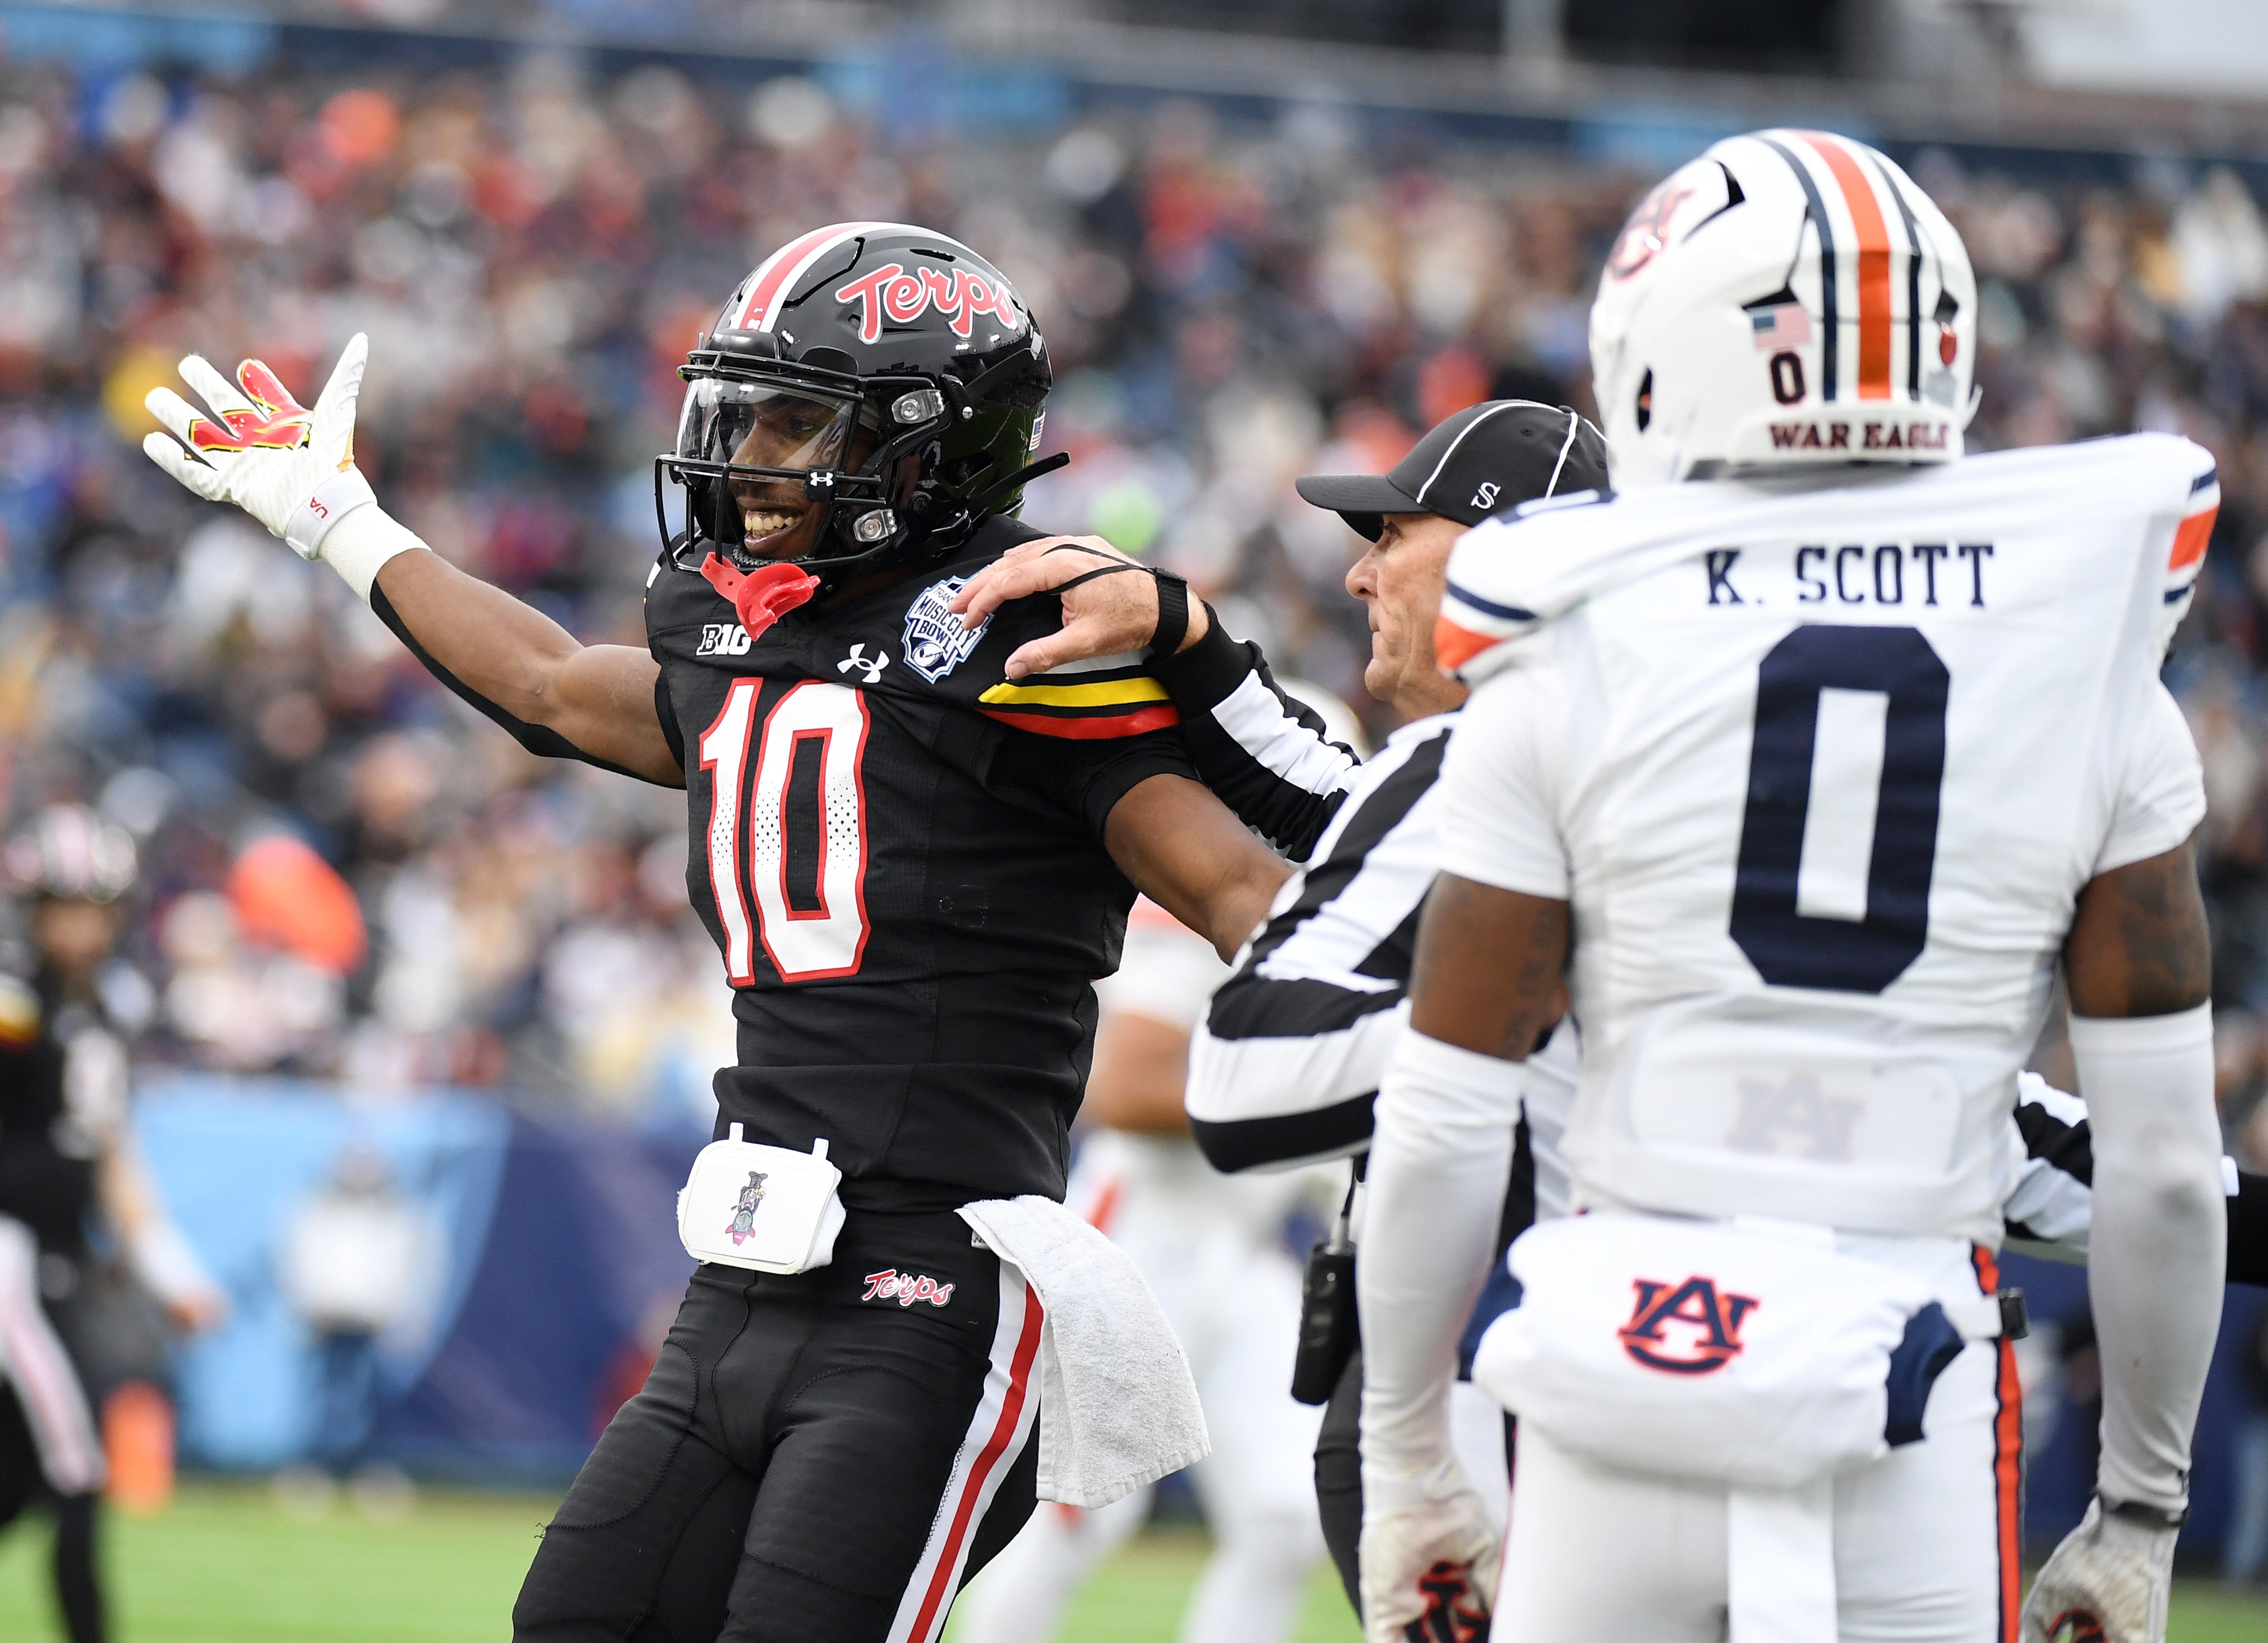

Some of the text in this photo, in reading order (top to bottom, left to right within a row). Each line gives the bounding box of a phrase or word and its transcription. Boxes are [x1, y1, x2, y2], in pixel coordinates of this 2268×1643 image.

[1770, 423, 1849, 450] WAR
[310, 496, 328, 519] UA
[1705, 543, 1994, 607] K. SCOTT
[914, 595, 977, 650] MUSIC CITY
[917, 620, 952, 654] BOWL
[699, 676, 871, 986] 10
[1729, 624, 1950, 995] 0
[862, 1268, 954, 1307] Terps
